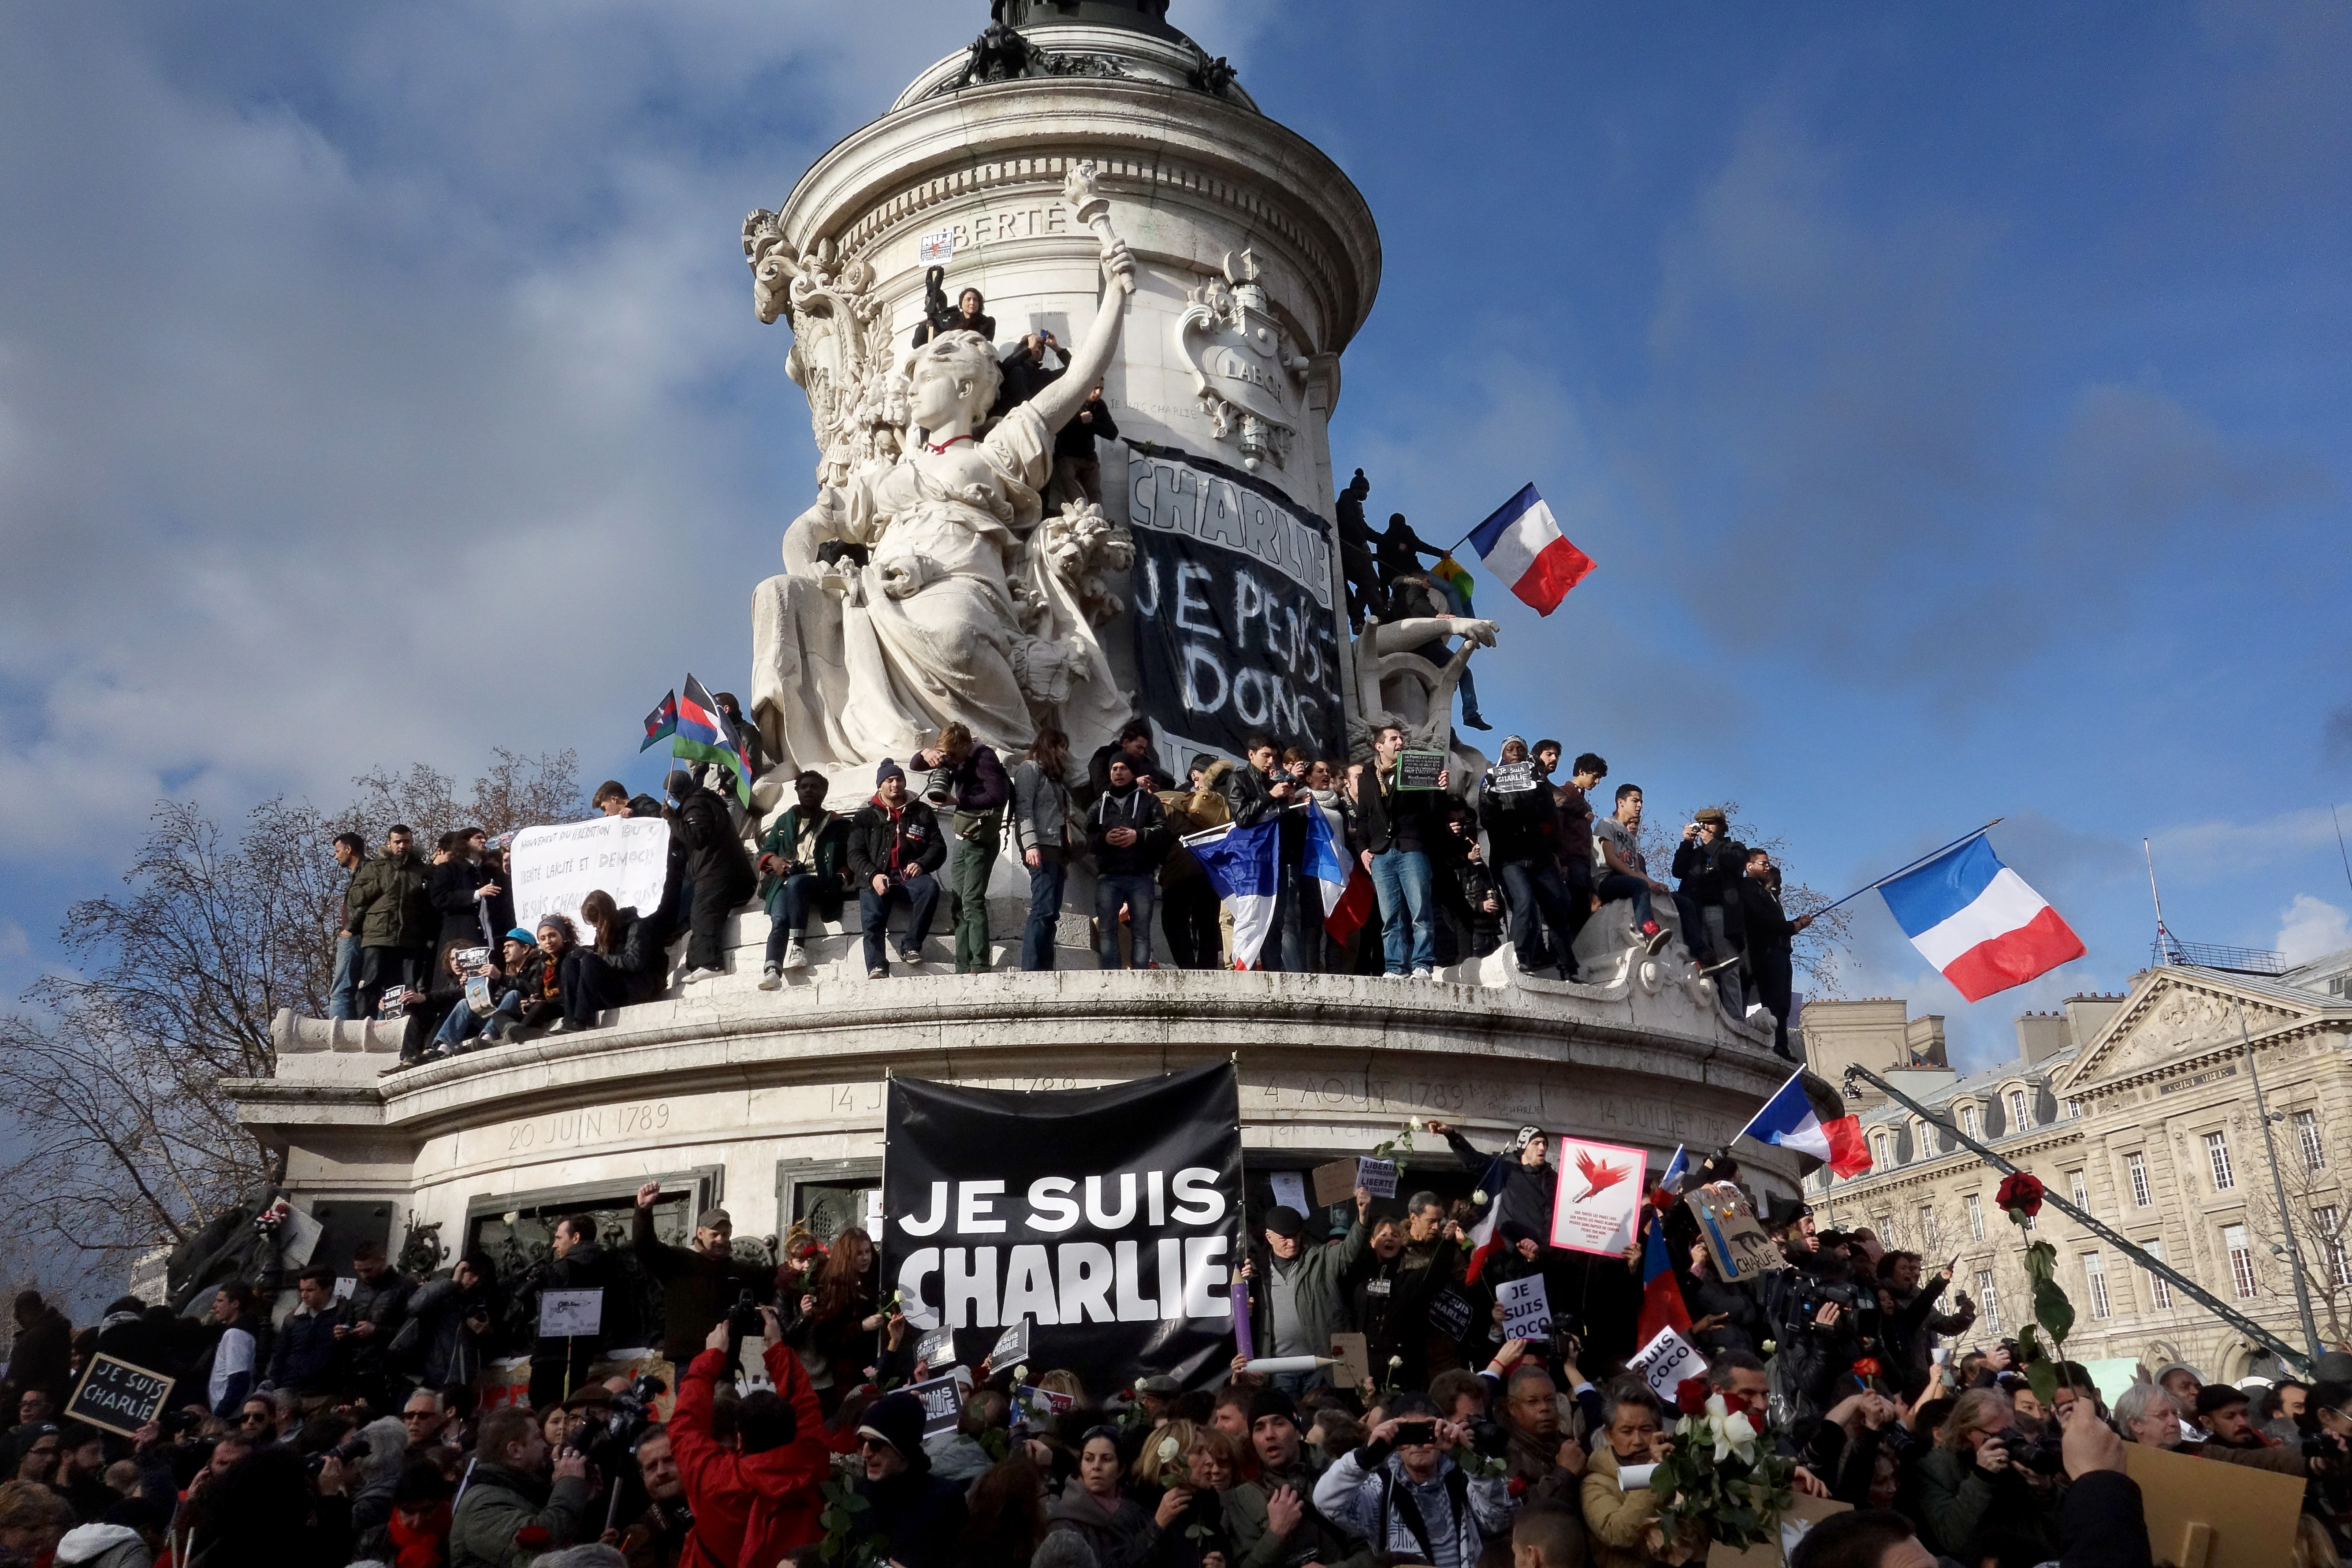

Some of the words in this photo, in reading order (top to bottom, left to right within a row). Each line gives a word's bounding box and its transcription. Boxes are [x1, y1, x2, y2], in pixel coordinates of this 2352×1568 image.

[943, 201, 1066, 248] BERTÉ
[922, 232, 952, 246] NUJ
[1226, 358, 1282, 403] LABOR
[1110, 399, 1120, 410] JE
[1124, 401, 1146, 411] SUIS
[1151, 404, 1198, 419] CHARLIE
[1129, 459, 1329, 605] CHARLIE
[1135, 557, 1223, 638] JE
[1236, 570, 1340, 704] PENSE
[1182, 644, 1322, 748] DONC
[622, 824, 640, 838] DU
[579, 857, 589, 871] ET
[599, 848, 654, 868] DEMOCR
[467, 949, 486, 958] SUIS
[391, 989, 401, 998] SUIS
[830, 1086, 853, 1113] 14
[1264, 1076, 1279, 1102] 4
[1410, 1081, 1464, 1110] 1789
[508, 1125, 535, 1151] 20
[544, 1110, 602, 1146] JUIN
[617, 1103, 670, 1135] 1789
[1599, 1100, 1617, 1124] 14
[1627, 1103, 1696, 1136] JUILLET
[1699, 1114, 1730, 1143] 1790
[1361, 1177, 1395, 1188] LIBERTÉ
[898, 1180, 1006, 1236] JE
[1024, 1167, 1225, 1233] SUIS
[897, 1236, 1231, 1330] CHARLIE
[1511, 1283, 1530, 1300] JE
[1448, 1298, 1470, 1315] SUIS
[1504, 1298, 1544, 1322] SUIS
[924, 1334, 942, 1347] SUIS
[993, 1338, 1019, 1357] CHARLIE
[1002, 1331, 1018, 1344] SUIS
[1639, 1333, 1675, 1371] SUIS
[97, 1363, 123, 1382] JE
[1650, 1346, 1690, 1388] COCO
